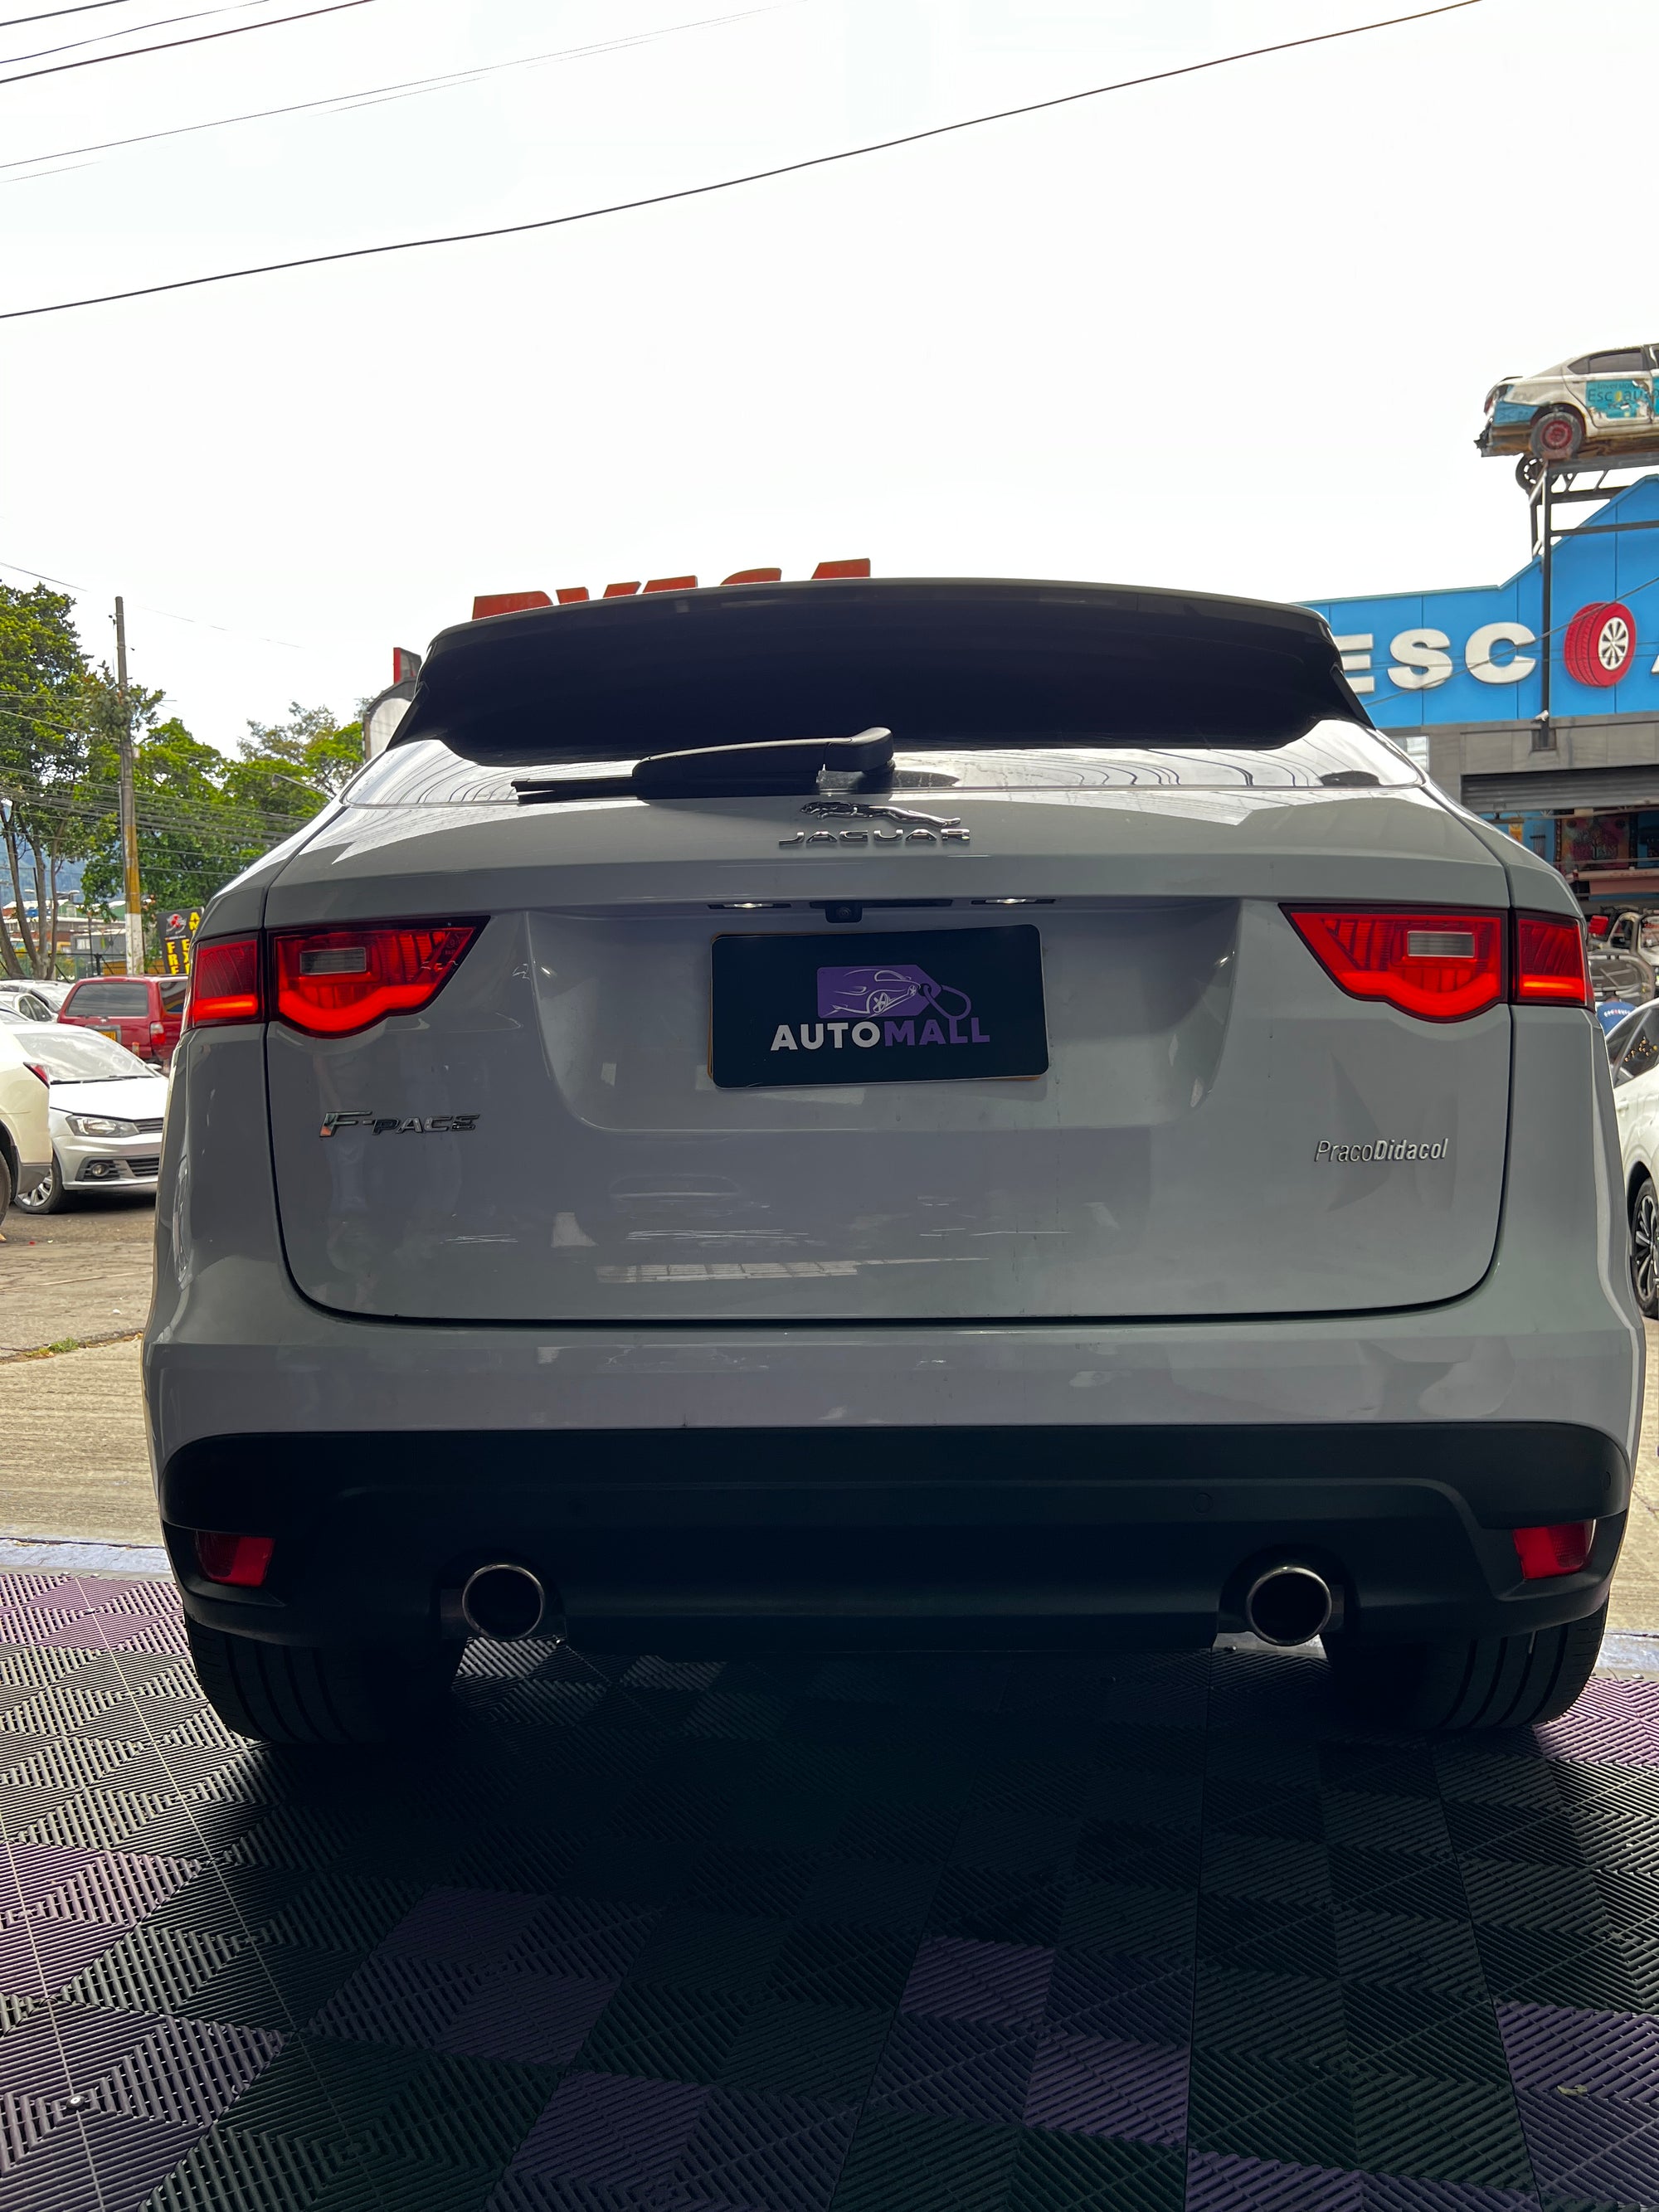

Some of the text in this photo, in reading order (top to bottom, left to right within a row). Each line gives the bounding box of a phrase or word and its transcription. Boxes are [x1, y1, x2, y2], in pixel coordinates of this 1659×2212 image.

[779, 829, 971, 844] JAGUAR
[771, 1017, 990, 1051] AUTOMALL
[319, 1111, 481, 1137] F-PACE
[1315, 1138, 1449, 1162] PracoDidacol
